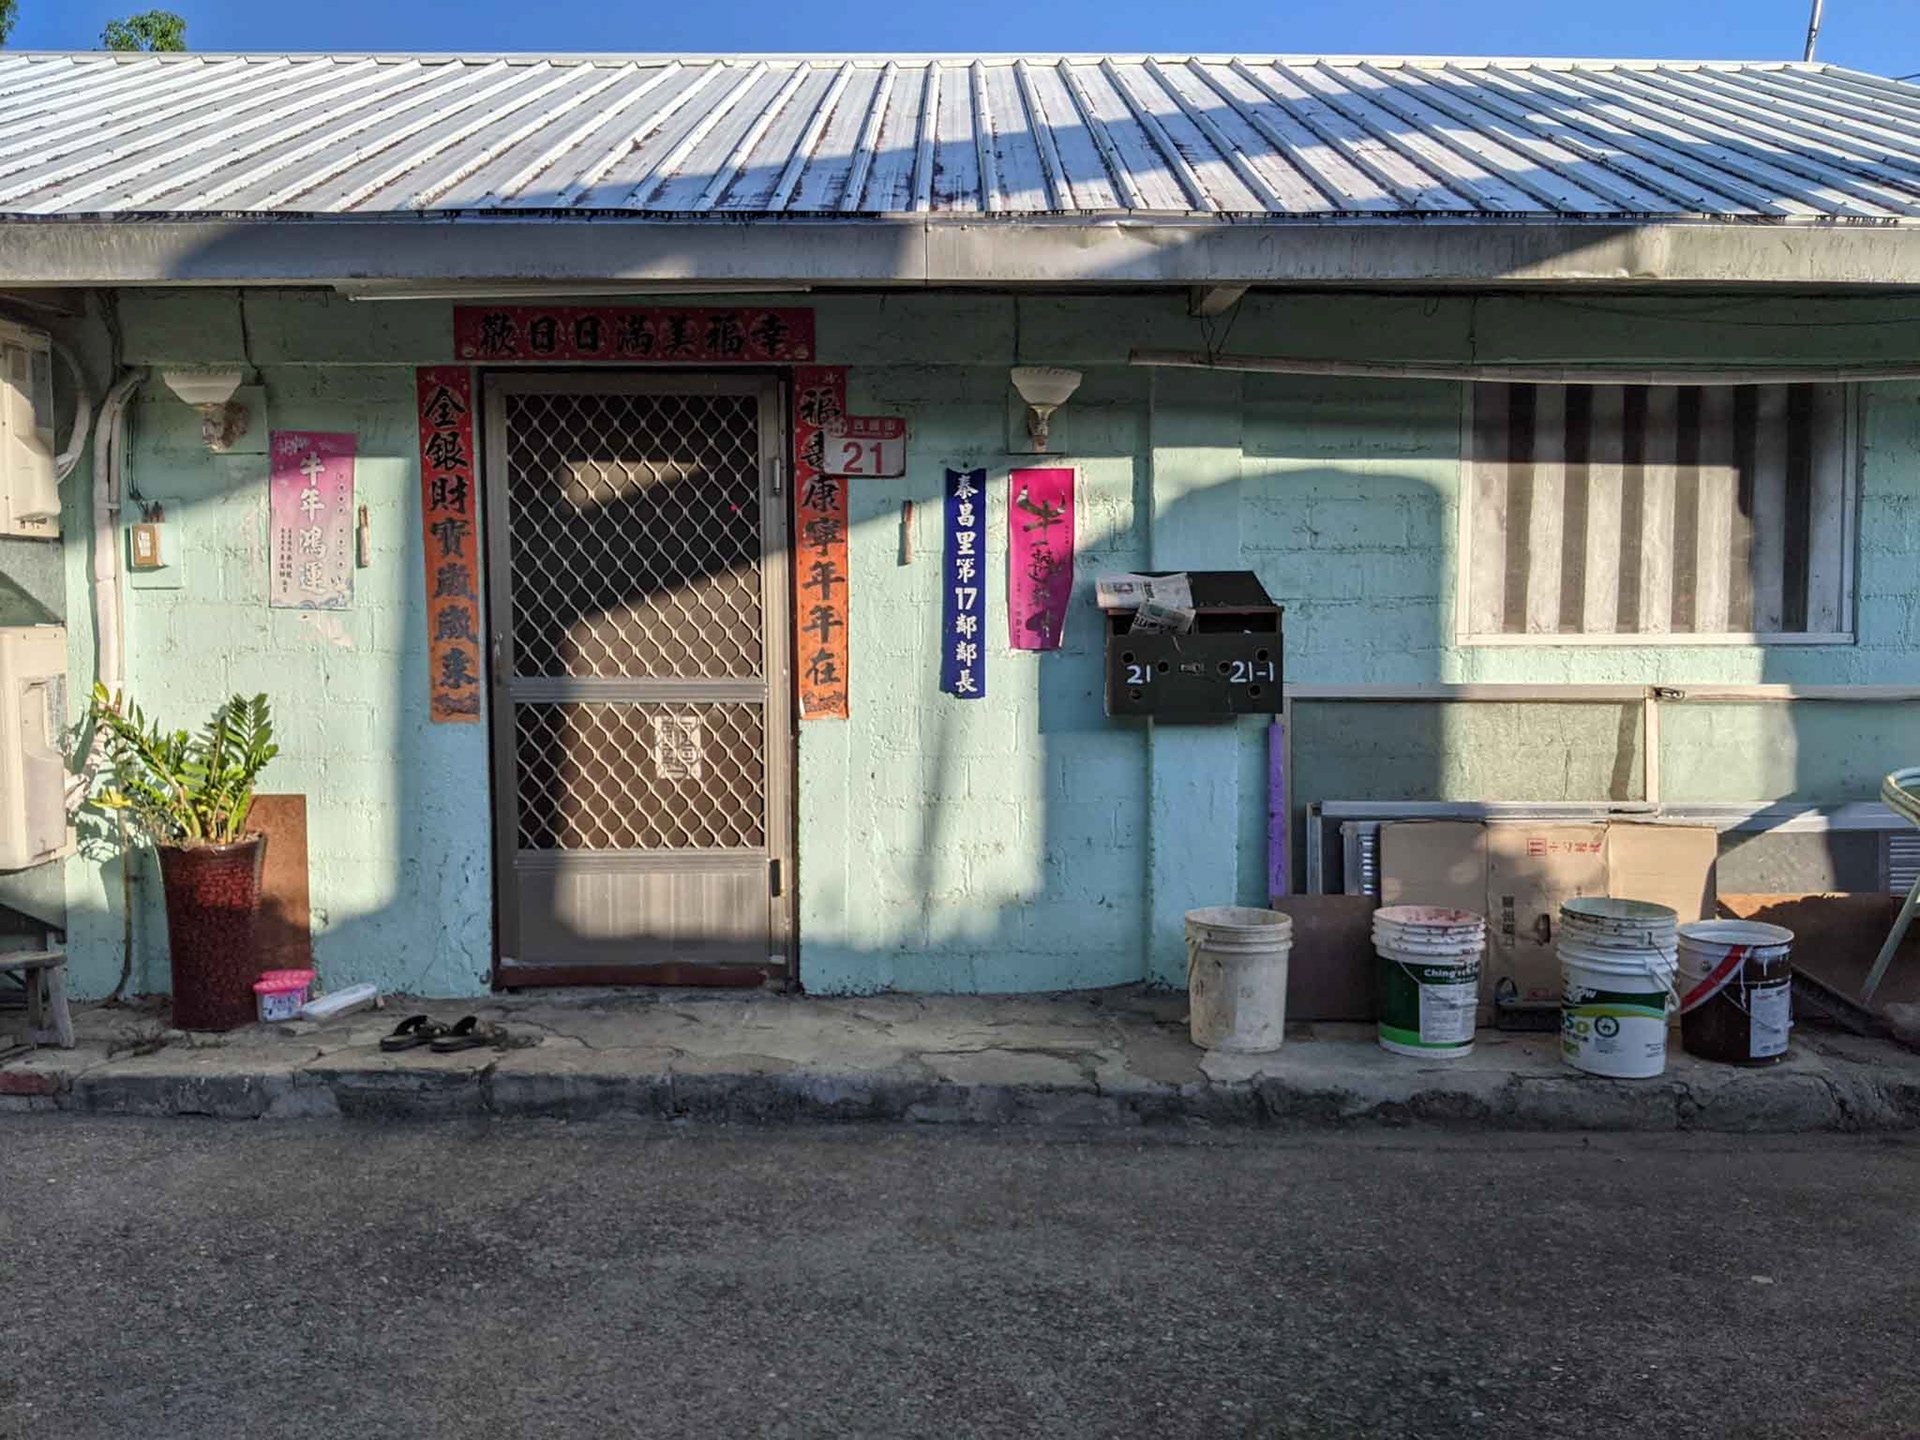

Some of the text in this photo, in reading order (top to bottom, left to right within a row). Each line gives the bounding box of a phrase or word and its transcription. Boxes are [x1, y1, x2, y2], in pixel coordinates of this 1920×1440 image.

[842, 441, 883, 474] 21
[1126, 664, 1151, 684] 21
[1229, 660, 1274, 683] 21-1
